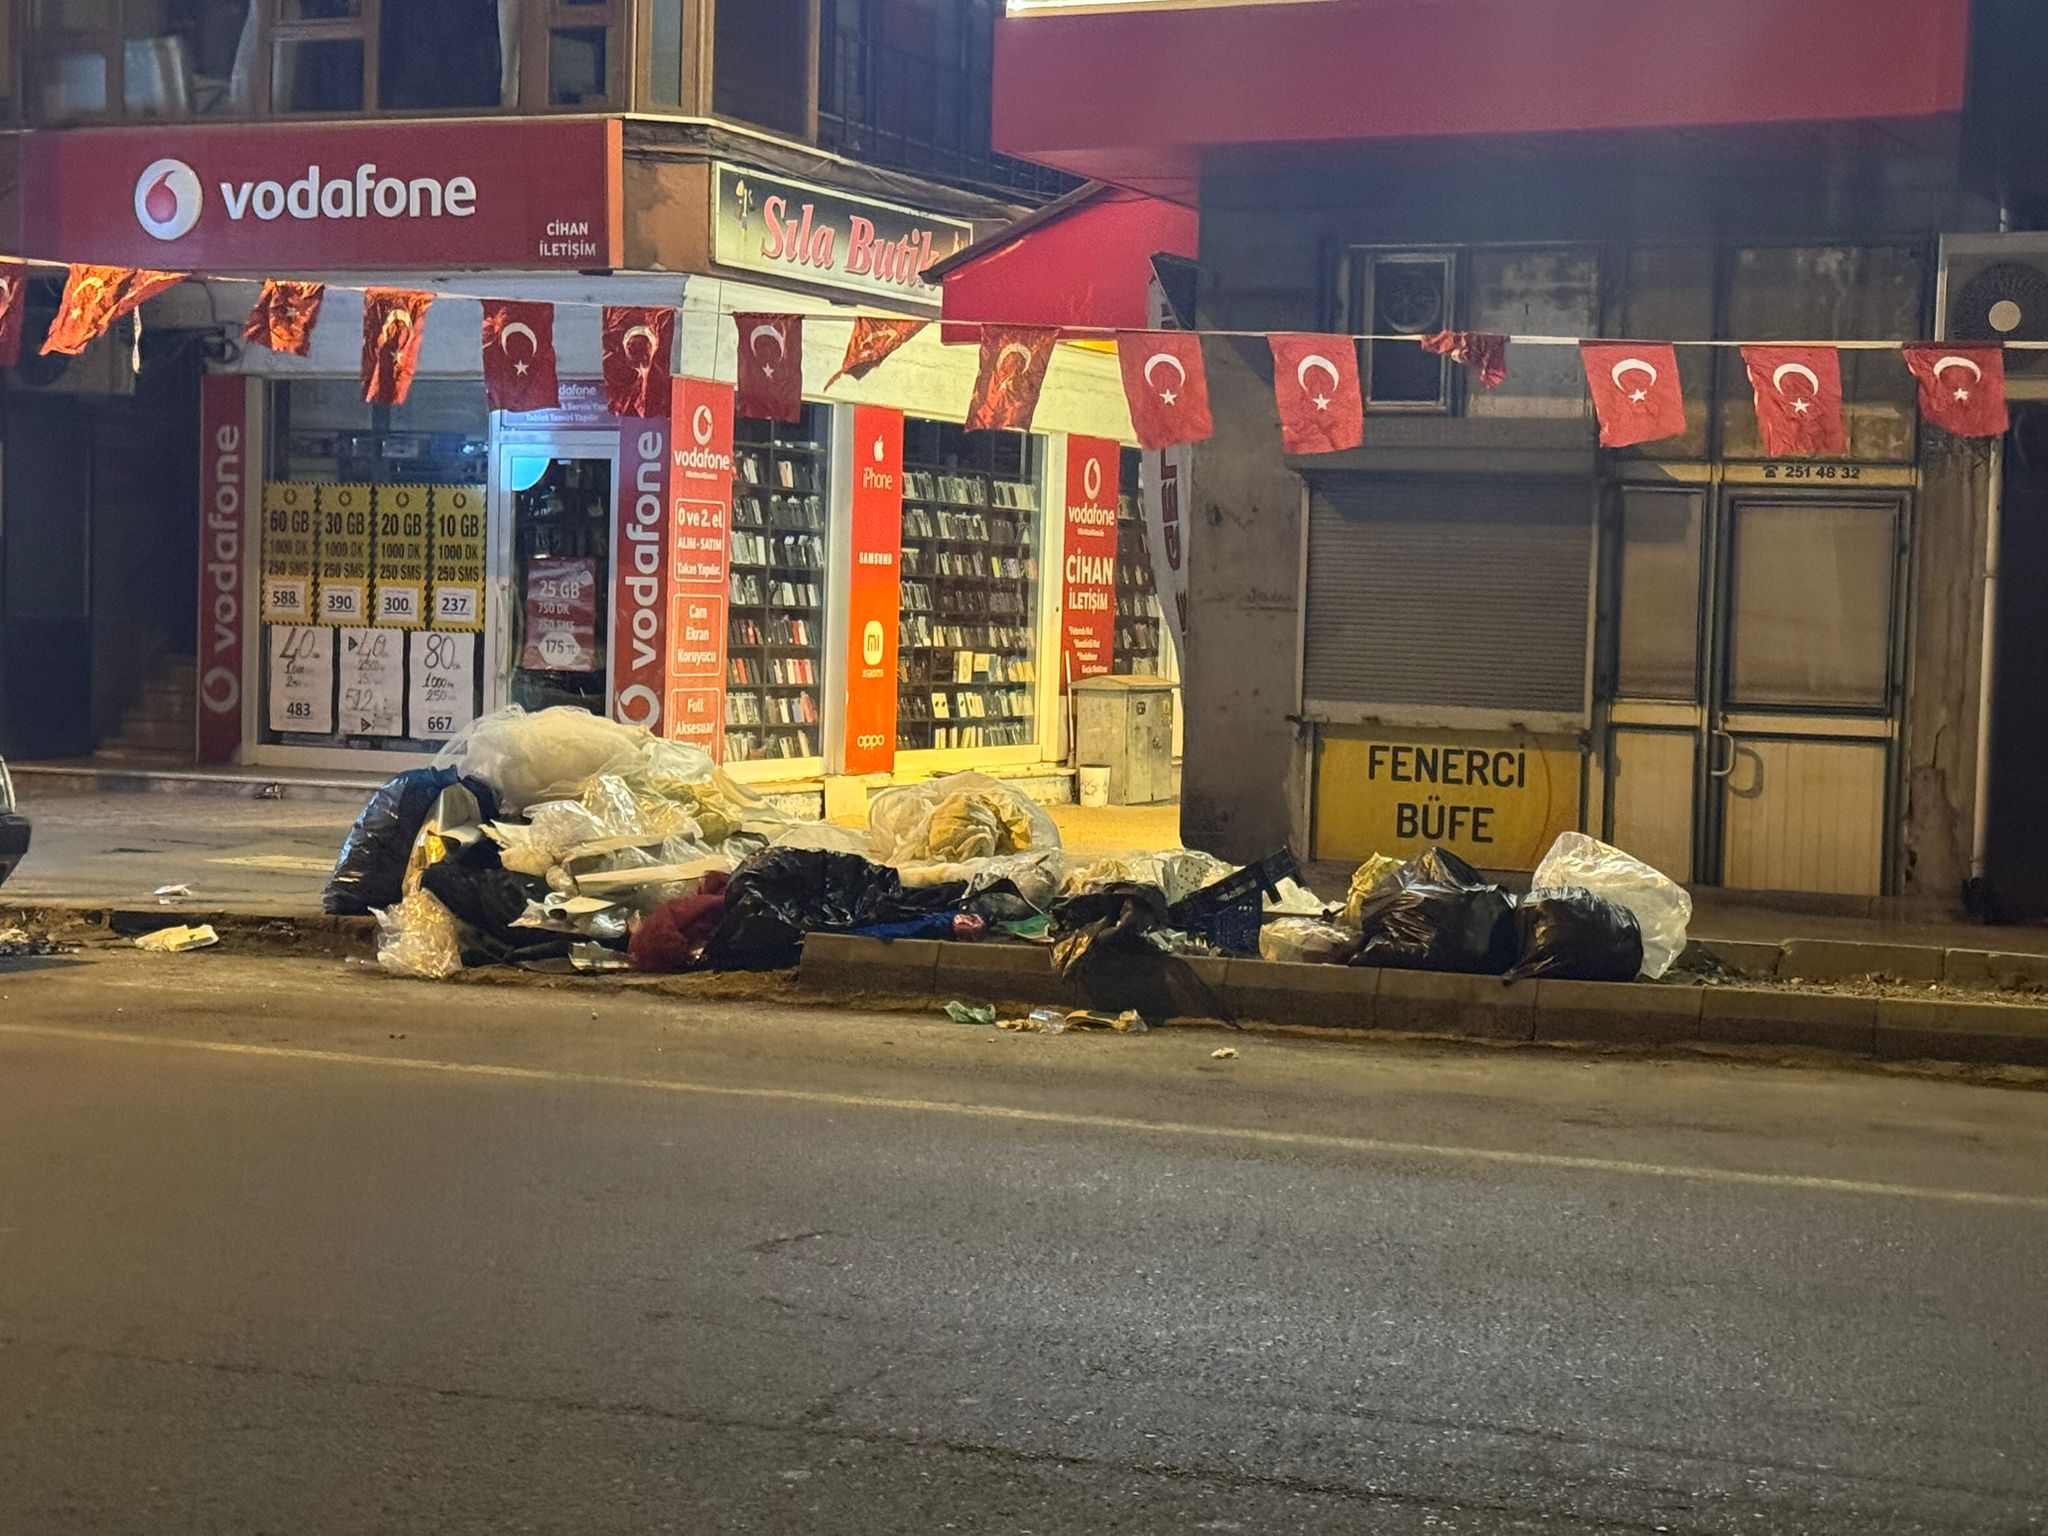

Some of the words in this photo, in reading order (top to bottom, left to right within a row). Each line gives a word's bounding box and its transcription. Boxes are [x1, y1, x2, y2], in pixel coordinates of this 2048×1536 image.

[219, 163, 477, 220] vodafone
[546, 219, 589, 236] CİHAN
[539, 239, 596, 259] İLETİŞİM
[760, 195, 835, 267] Sıla
[844, 215, 940, 289] Butik
[558, 383, 597, 396] dafone
[673, 448, 730, 470] vodafone
[863, 467, 893, 490] iPhone
[1785, 466, 1811, 478] 251
[1816, 466, 1836, 478] 48
[1841, 467, 1860, 479] 32
[270, 510, 286, 532] 60
[292, 511, 309, 533] GB
[687, 511, 699, 526] ve
[712, 510, 723, 528] el
[1068, 506, 1115, 526] vodafone
[325, 513, 342, 535] 30
[347, 513, 364, 536] GB
[381, 514, 399, 536] 20
[404, 514, 422, 536] GB
[439, 516, 456, 538] 10
[461, 516, 479, 538] GB
[208, 424, 239, 652] vodafone
[325, 541, 347, 557] 1000
[382, 543, 404, 559] 1000
[408, 544, 421, 559] DK
[439, 544, 462, 560] 1000
[465, 544, 478, 560] DK
[625, 431, 663, 670] vodafone
[859, 551, 893, 565] SAMSUNG
[324, 563, 341, 578] 250
[380, 565, 398, 580] 250
[401, 565, 421, 581] SMS
[437, 566, 456, 582] 250
[459, 566, 479, 581] SMS
[1066, 548, 1114, 585] CİHAN
[540, 580, 557, 597] 25
[560, 580, 580, 599] GB
[272, 591, 296, 605] 588
[328, 596, 352, 610] 390
[384, 597, 409, 611] 300
[442, 598, 466, 612] 237
[1069, 587, 1108, 615] İLETİŞİM
[538, 602, 555, 614] 750
[556, 603, 570, 615] DK
[689, 605, 708, 619] Cam
[424, 633, 455, 669] 80
[545, 640, 564, 653] 175
[287, 702, 311, 716] 483
[687, 698, 704, 713] Full
[428, 716, 452, 730] 667
[857, 734, 885, 750] oppo
[1368, 742, 1525, 789] FENERCİ
[1396, 795, 1494, 843] BÜFE
